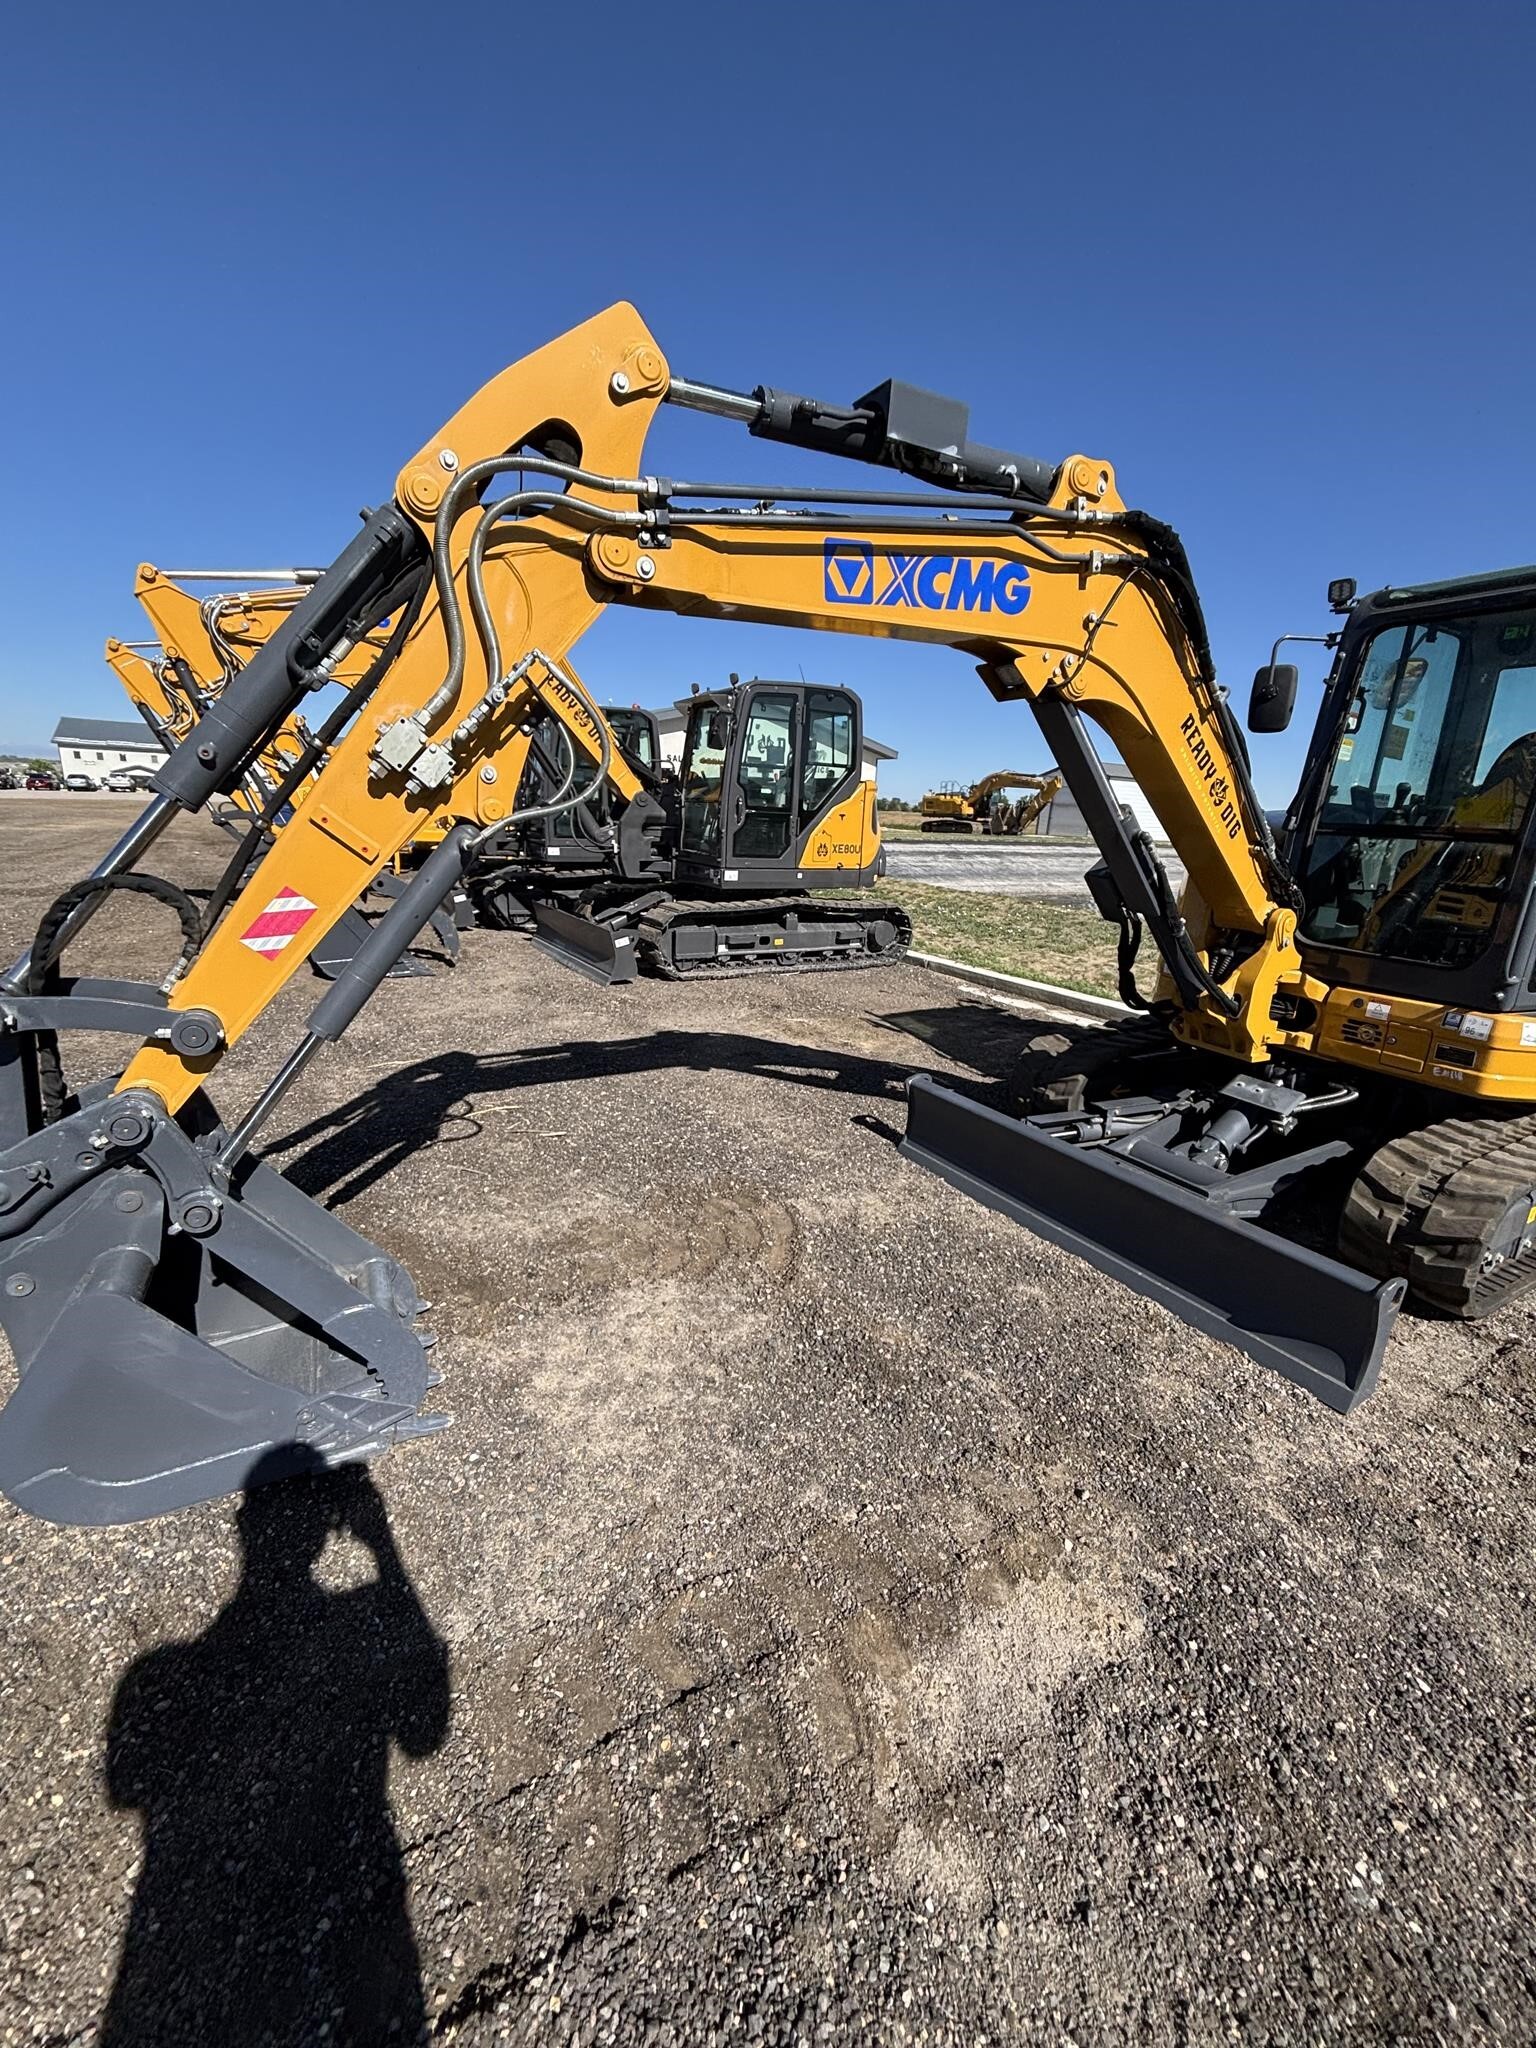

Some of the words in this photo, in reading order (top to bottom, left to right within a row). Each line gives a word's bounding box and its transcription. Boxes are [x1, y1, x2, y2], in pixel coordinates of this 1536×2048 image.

[875, 551, 1031, 615] XCMG
[1180, 713, 1217, 781] READY
[1220, 802, 1242, 839] DIG
[832, 844, 860, 854] XE80U
